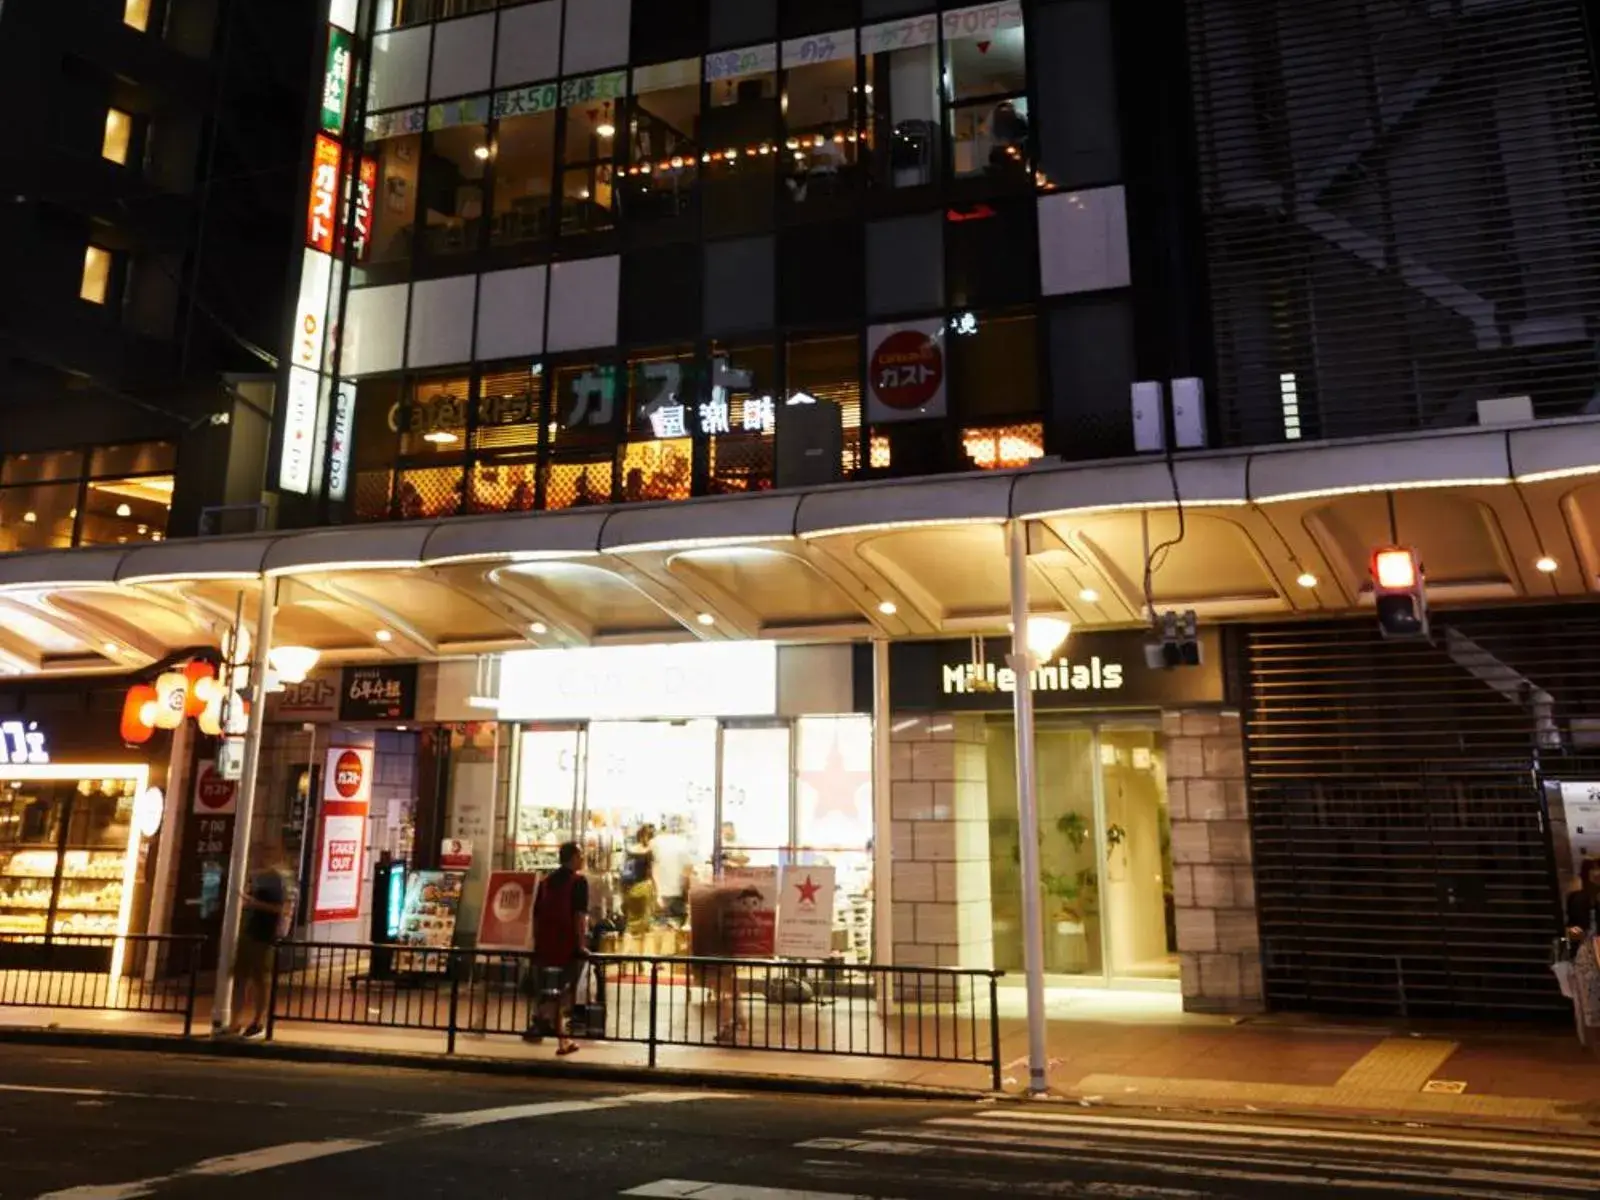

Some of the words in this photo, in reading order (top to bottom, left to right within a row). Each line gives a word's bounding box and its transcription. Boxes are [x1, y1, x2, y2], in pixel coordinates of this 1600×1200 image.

[311, 163, 337, 242] ガスト
[568, 357, 753, 427] ガスト
[880, 363, 936, 388] ガスト
[942, 656, 1123, 694] Millenials
